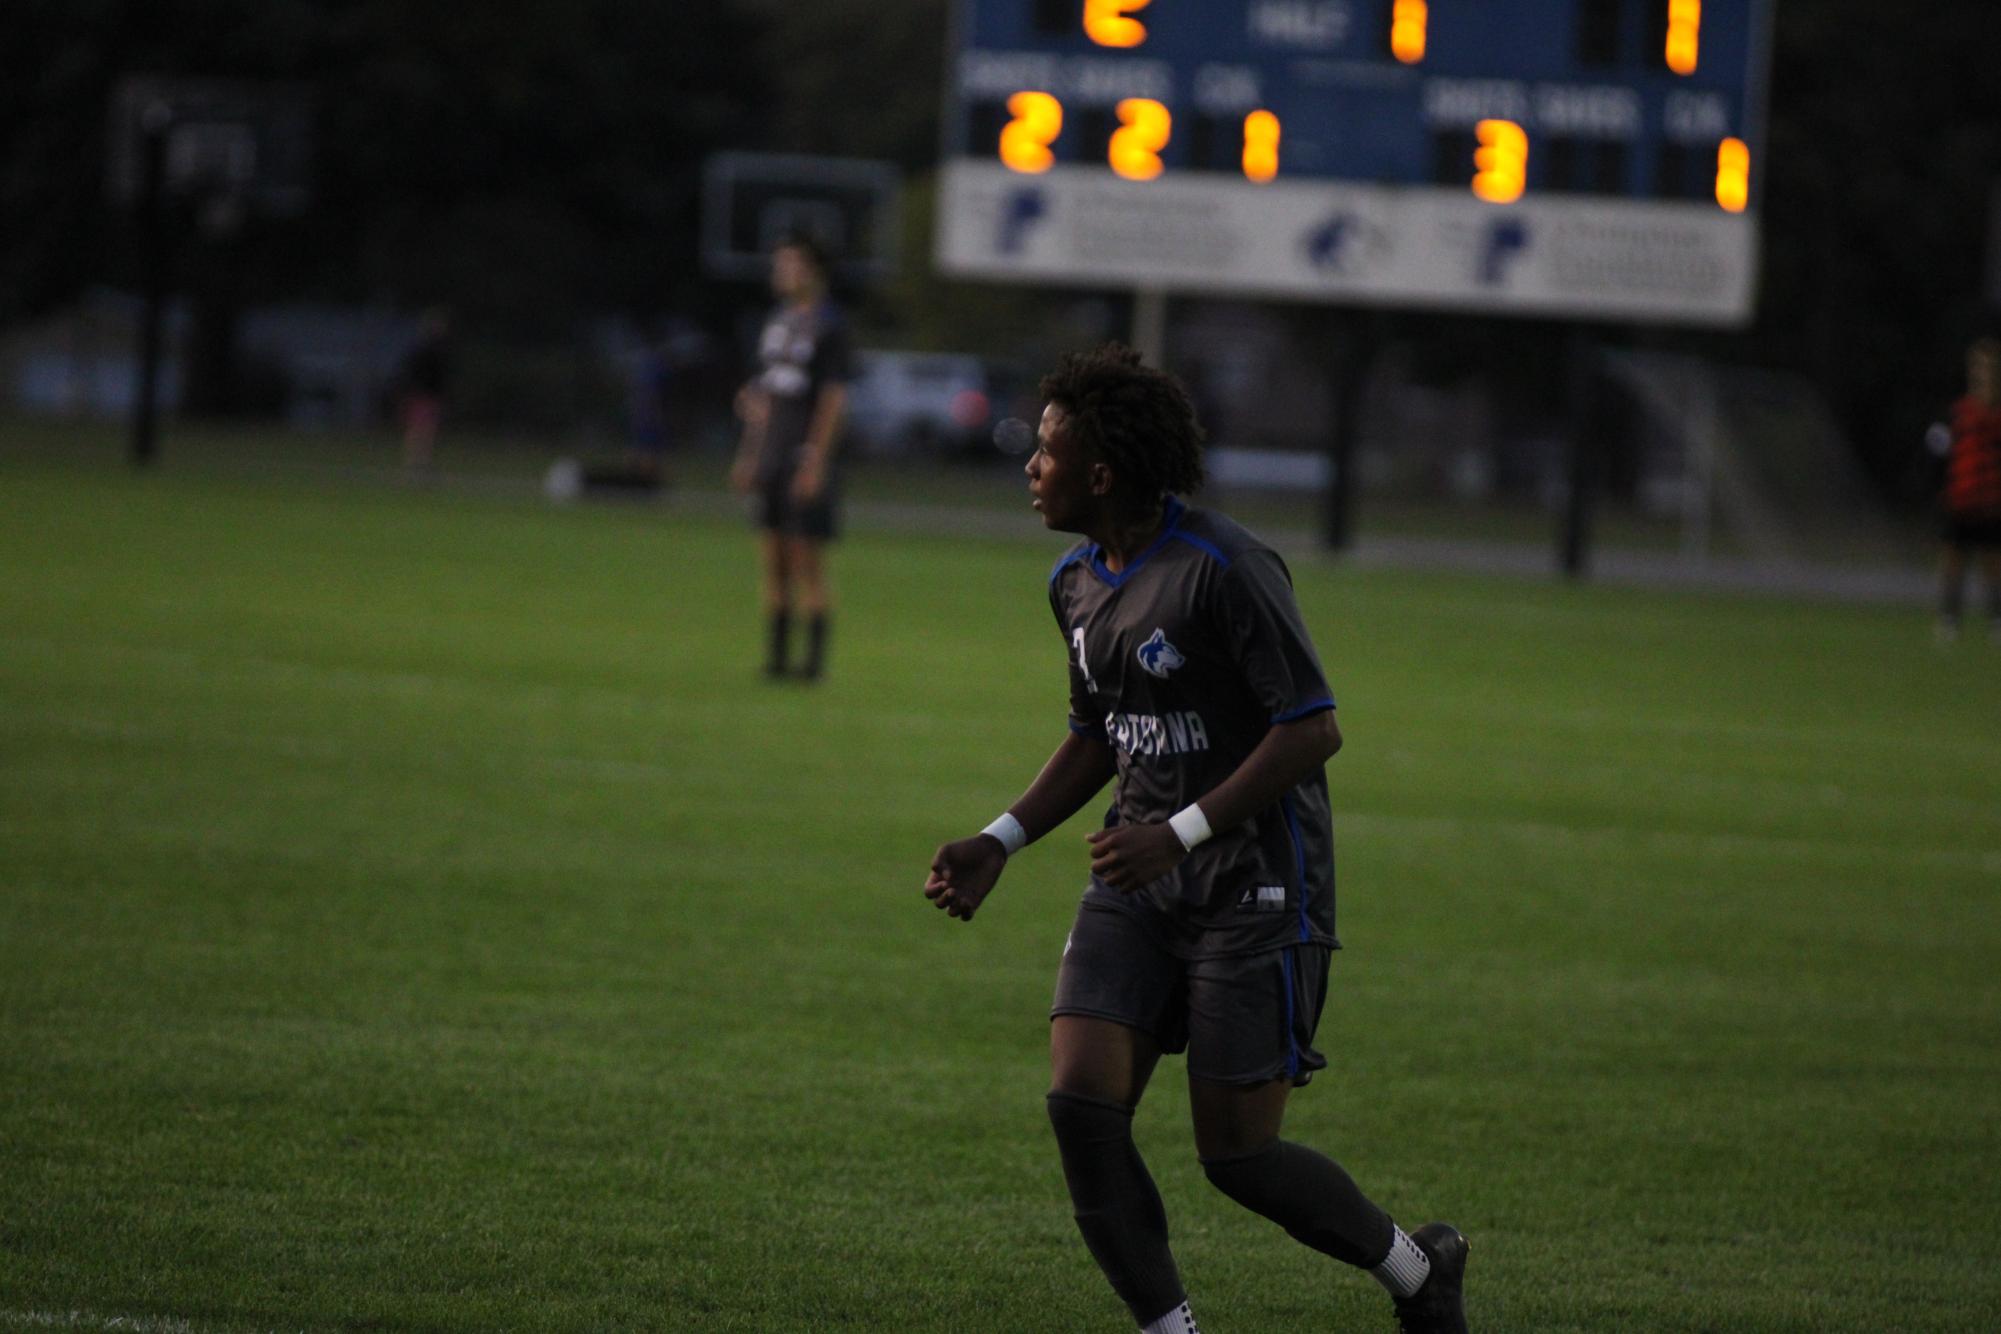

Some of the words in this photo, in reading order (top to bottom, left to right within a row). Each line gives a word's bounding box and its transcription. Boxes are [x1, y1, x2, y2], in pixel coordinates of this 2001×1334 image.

[999, 91, 1063, 174] 2
[1108, 98, 1171, 181] 2
[1242, 109, 1281, 184] 1
[1472, 119, 1529, 204] 3
[1716, 137, 1750, 213] 1
